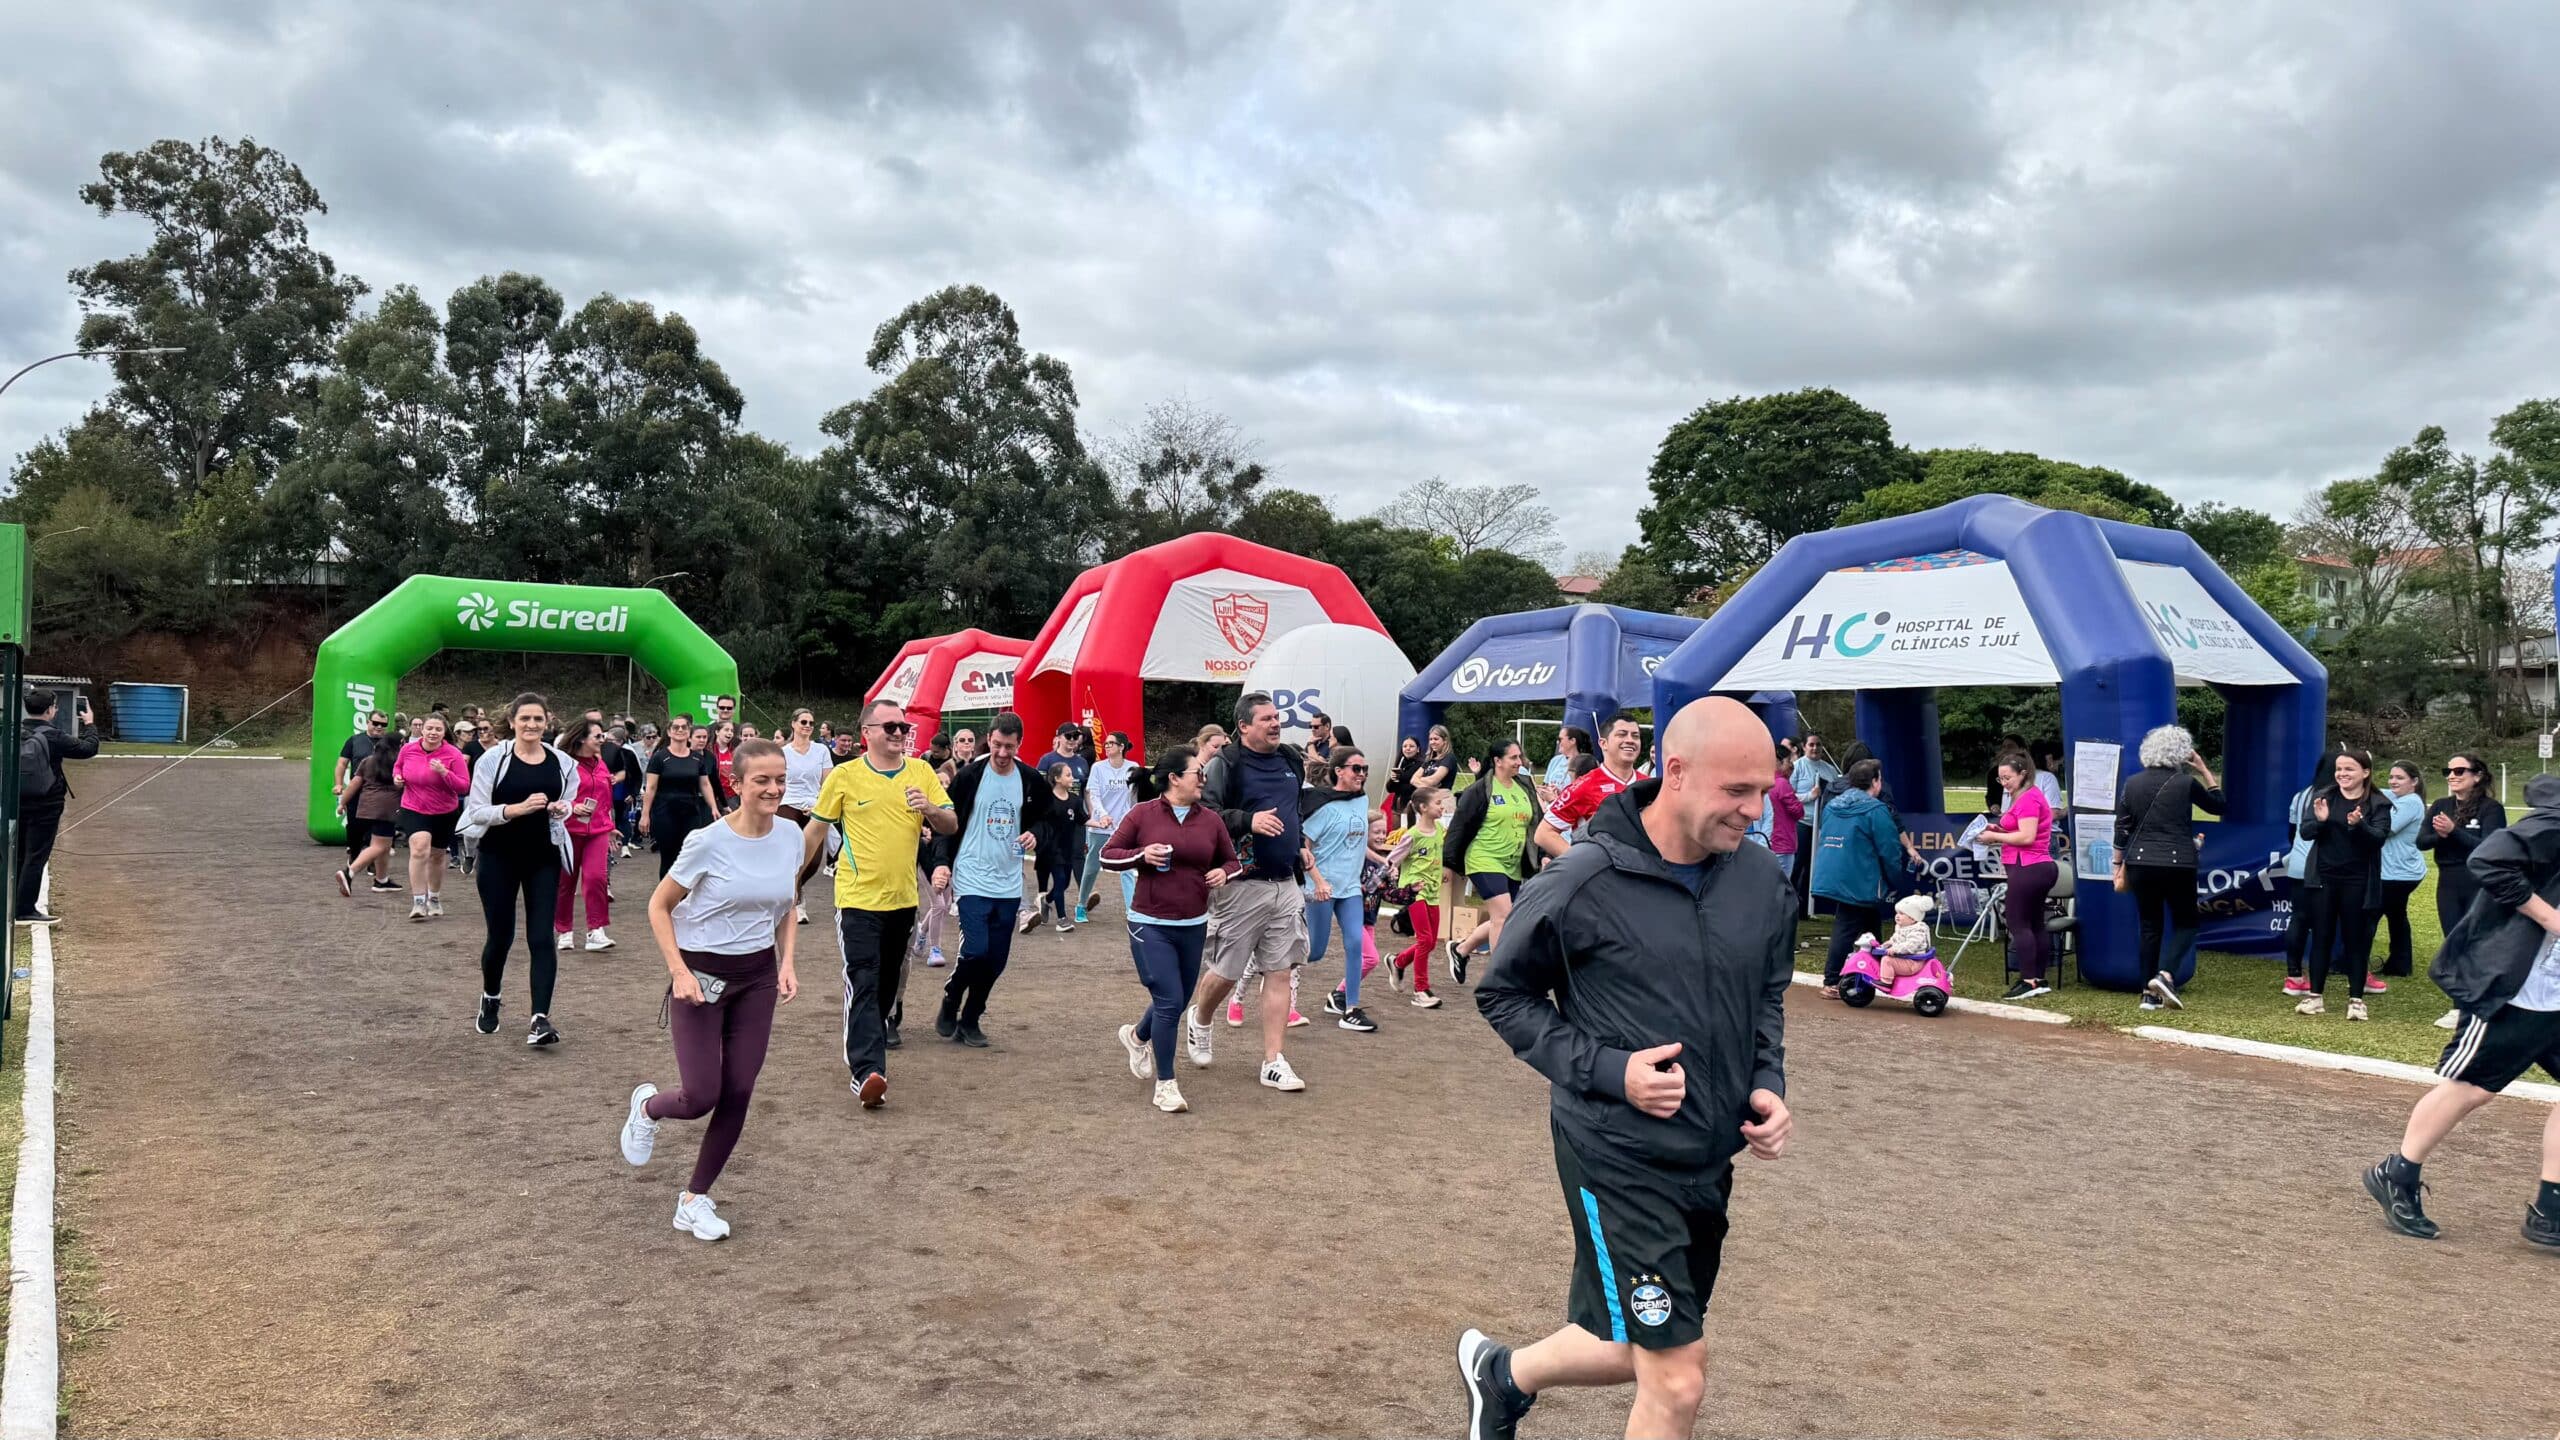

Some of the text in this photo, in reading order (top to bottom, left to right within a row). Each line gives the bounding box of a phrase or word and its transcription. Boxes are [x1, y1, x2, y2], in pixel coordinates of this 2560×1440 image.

[506, 599, 629, 632] Sicredi
[1896, 616, 2006, 634] HOSPITAL DE
[1890, 631, 2021, 651] CLÍNICAS IJUÍ
[1204, 660, 1248, 671] NOSSO
[1255, 689, 1322, 730] BS
